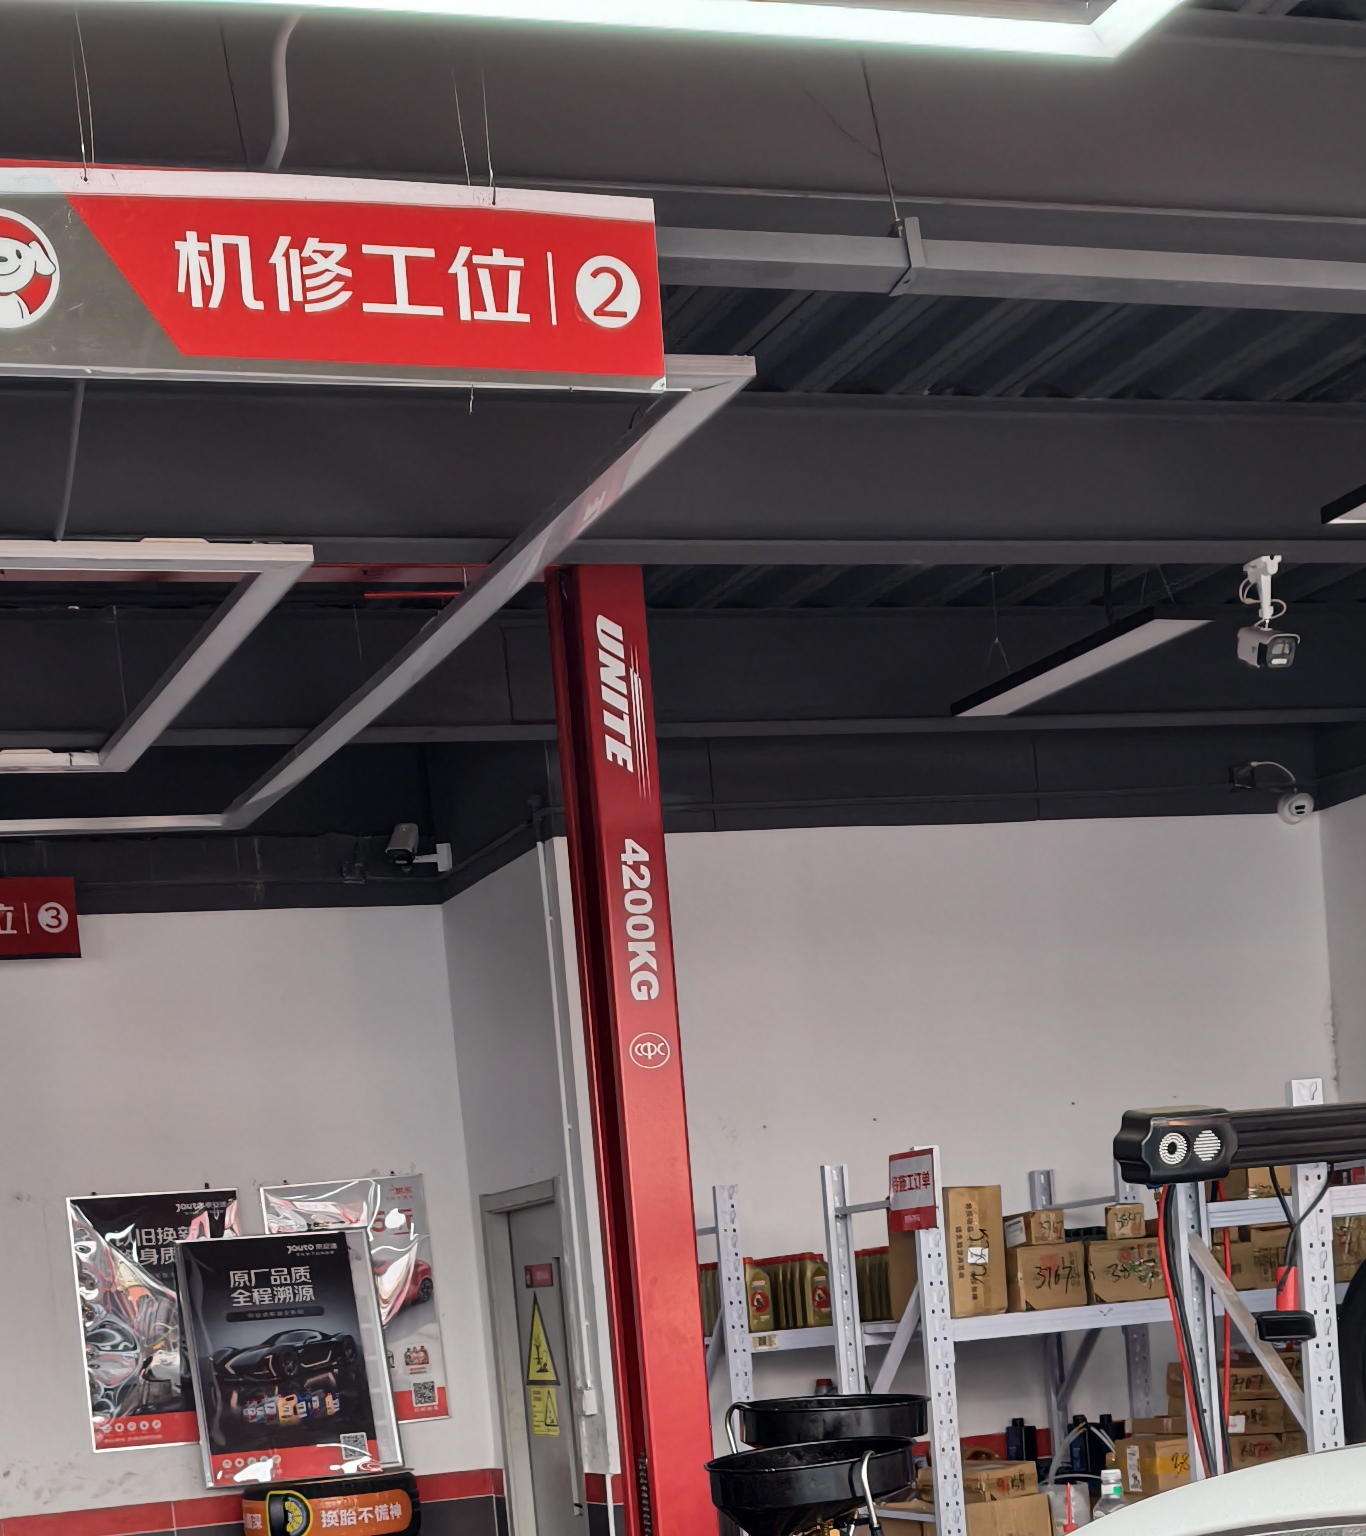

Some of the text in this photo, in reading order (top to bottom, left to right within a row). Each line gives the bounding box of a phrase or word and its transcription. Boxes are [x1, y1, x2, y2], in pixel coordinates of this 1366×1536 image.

[175, 230, 531, 323] 机修工位
[596, 614, 634, 773] UNITE
[618, 838, 660, 1001] 4200KG
[230, 1266, 312, 1288] 原厂品质
[231, 1285, 315, 1306] 全程溯源
[321, 1504, 402, 1528] 换胎不慌神
